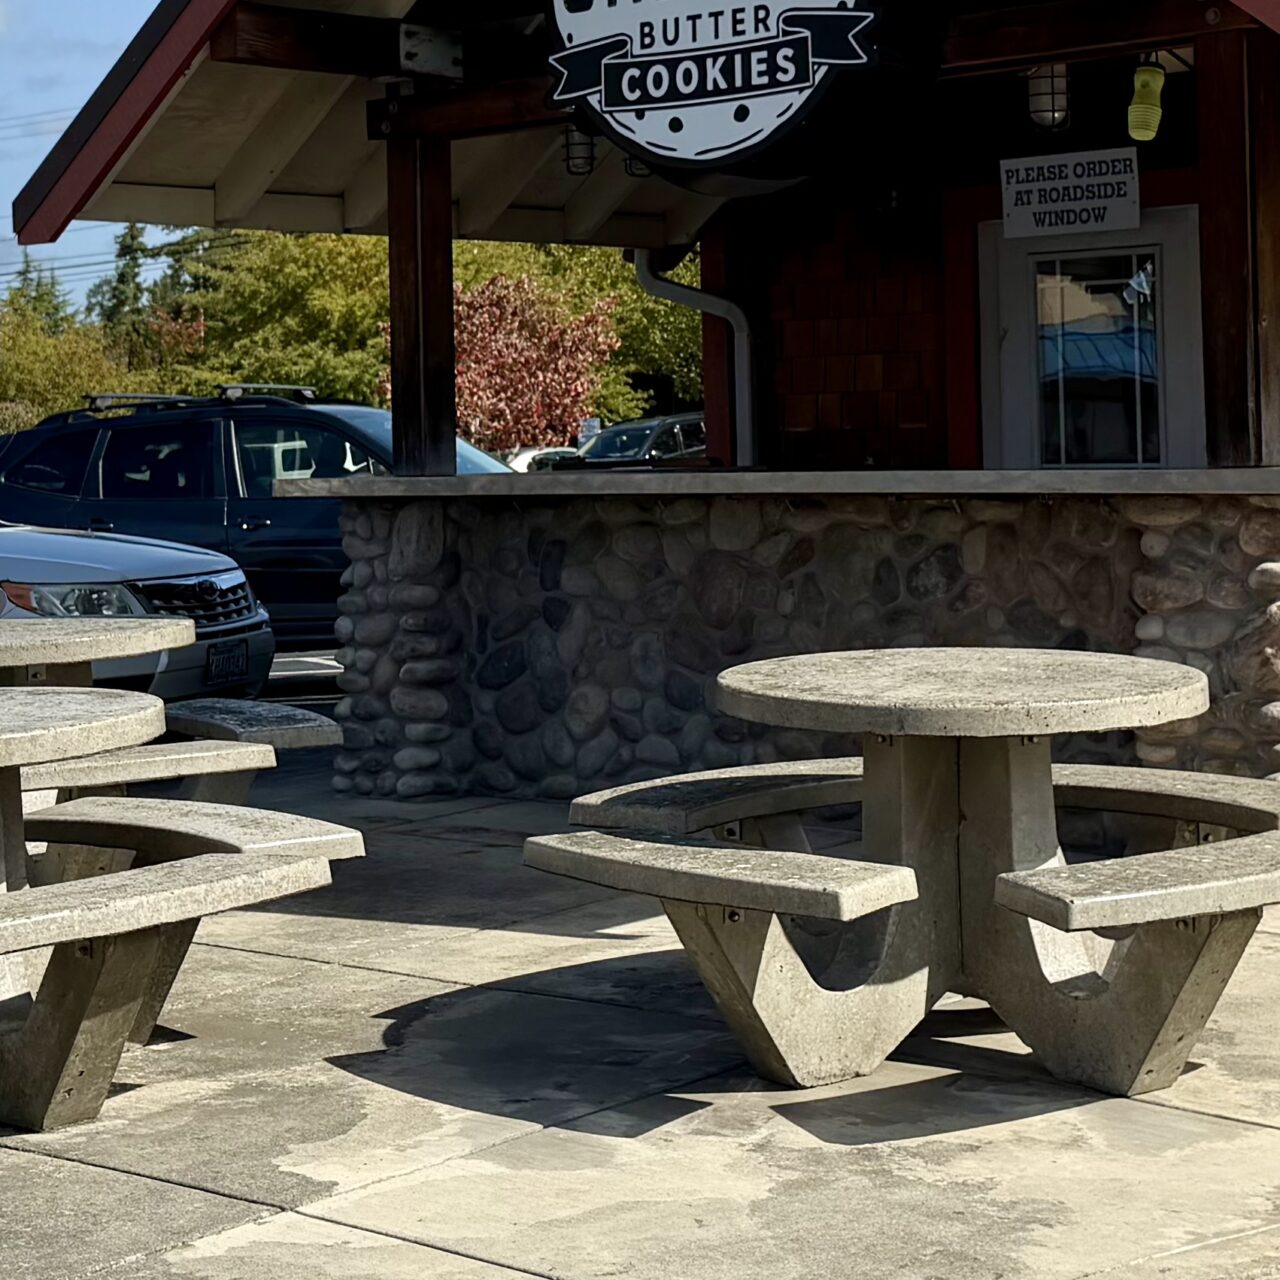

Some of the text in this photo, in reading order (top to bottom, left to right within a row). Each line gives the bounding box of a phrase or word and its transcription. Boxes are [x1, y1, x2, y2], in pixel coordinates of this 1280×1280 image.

[639, 4, 771, 50] BUTTER
[621, 47, 797, 101] COOKIES
[1005, 158, 1134, 185] PLEASE ORDER
[1014, 181, 1127, 207] AT ROADSIDE
[1032, 206, 1107, 228] WINDOW
